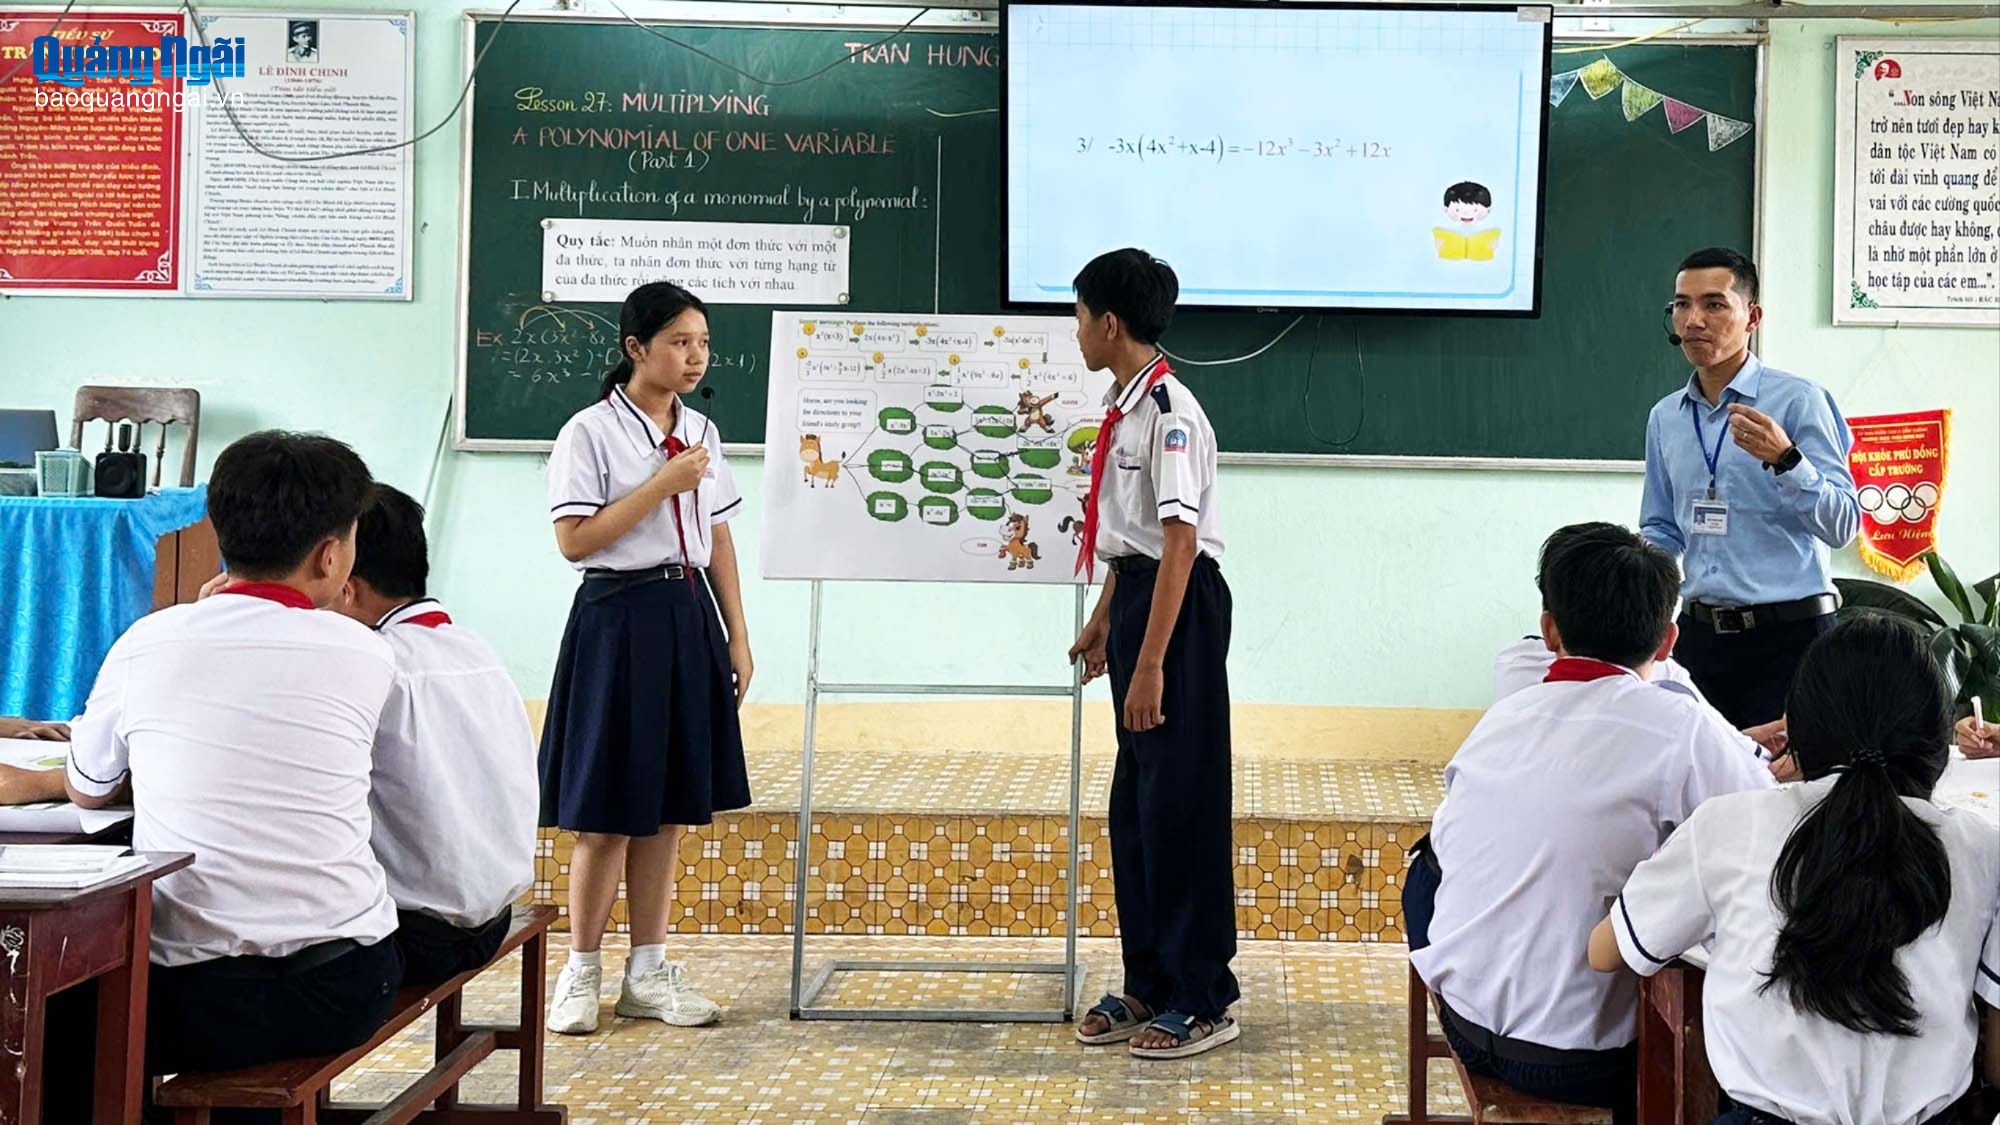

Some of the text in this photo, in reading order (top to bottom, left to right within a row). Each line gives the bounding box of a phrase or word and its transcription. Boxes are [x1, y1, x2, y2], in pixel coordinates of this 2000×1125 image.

[310, 67, 348, 78] CHINH
[514, 87, 577, 113] Lesson
[581, 91, 613, 113] 27:
[1929, 91, 1956, 111] sông
[1961, 90, 1984, 110] Việt
[1871, 116, 1888, 133] trở
[1892, 117, 1913, 133] nên
[1917, 117, 1939, 134] tươi
[1943, 117, 1964, 138] đẹp
[1968, 117, 1989, 138] hay
[512, 126, 529, 146] A
[693, 131, 720, 151] OF
[726, 131, 777, 152] ONE
[1870, 142, 1997, 163] dân tộc Việt Nam có
[1870, 168, 1885, 185] tới
[1914, 169, 1938, 185] vinh
[1943, 173, 1979, 190] quang
[1984, 166, 1998, 186] để
[665, 189, 681, 216] of
[684, 191, 695, 204] a
[704, 184, 790, 206] monomial
[798, 186, 815, 224] by
[819, 194, 832, 208] a
[1869, 193, 2000, 215] vai với các cường quốc
[1869, 219, 1896, 236] châu
[1900, 219, 1927, 240] được
[1931, 220, 1951, 241] hay
[1955, 220, 1994, 241] không,
[556, 231, 837, 254] Quy tắc: Muốn nhân một đơn thức với một
[555, 254, 571, 266] đa
[576, 255, 608, 268] thức,
[613, 257, 627, 268] ta
[630, 256, 661, 269] nhân
[666, 256, 692, 269] đơn
[696, 256, 724, 270] thức
[729, 257, 749, 270] với
[754, 257, 783, 272] từng
[788, 259, 818, 275] hạng
[1868, 244, 1998, 266] là nhờ một phần lớn ở
[581, 273, 597, 286] đa
[600, 273, 629, 287] thức
[688, 275, 709, 288] các
[712, 276, 737, 290] tích
[740, 277, 761, 291] với
[1868, 271, 1888, 292] học
[1892, 272, 1911, 292] tập
[1914, 270, 1934, 288] của
[1938, 272, 1957, 289] các
[1851, 448, 1867, 464] HỘI
[1868, 462, 1923, 477] CẤP TRƯỜNG
